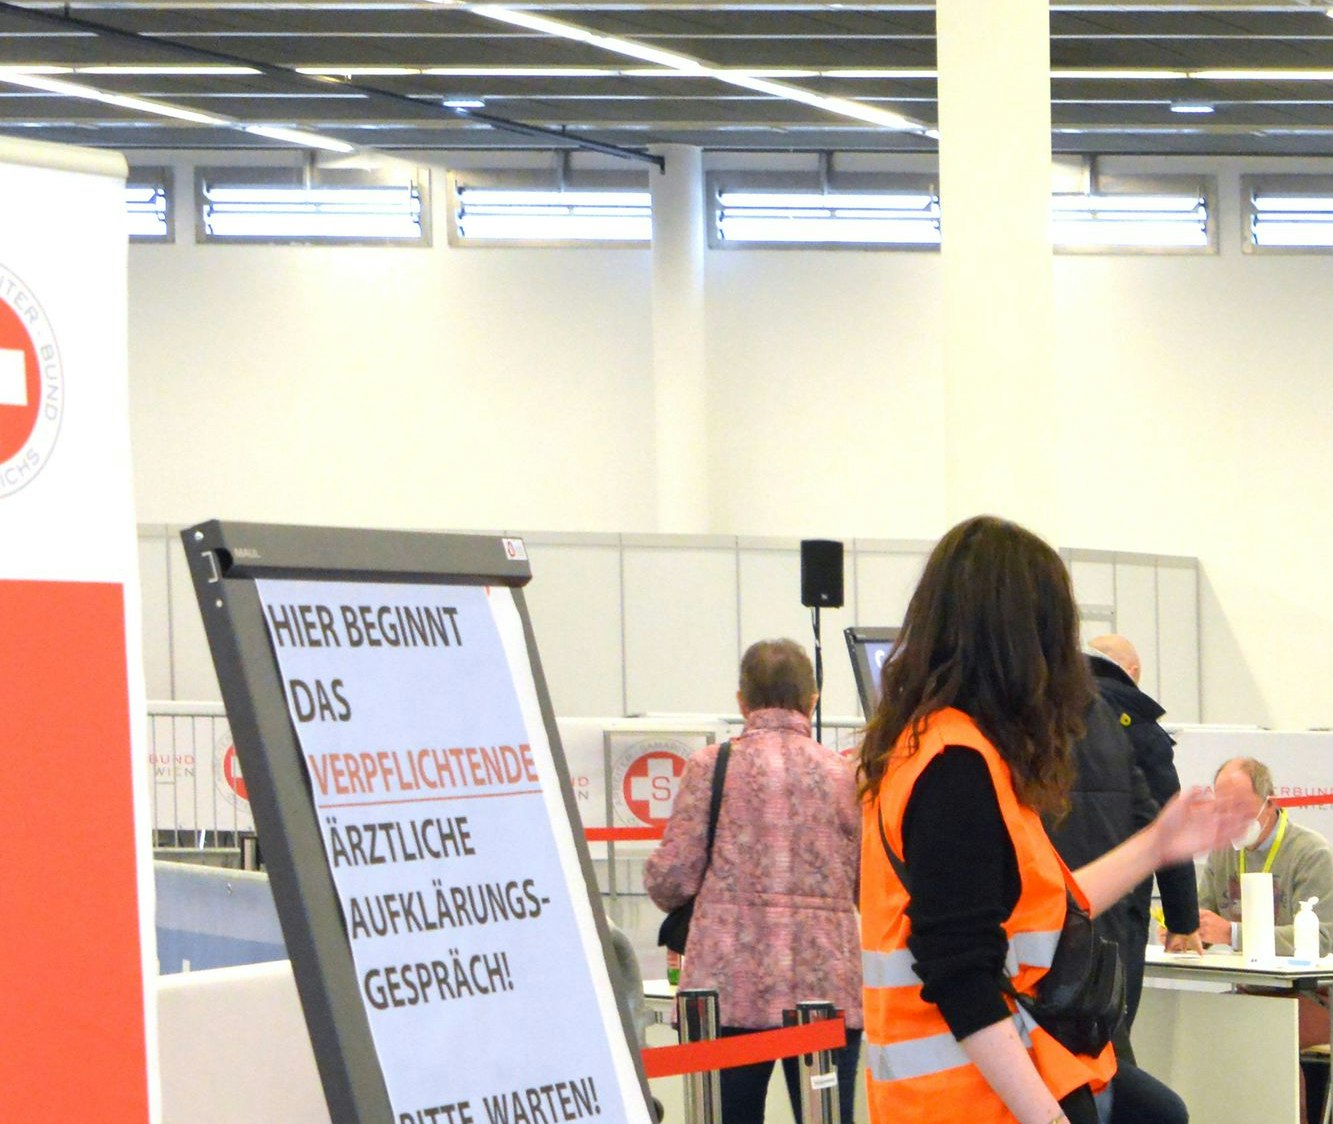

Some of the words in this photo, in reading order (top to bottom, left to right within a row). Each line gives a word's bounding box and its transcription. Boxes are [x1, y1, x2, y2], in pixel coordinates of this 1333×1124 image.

[40, 344, 59, 421] BUND
[267, 604, 339, 648] HIER
[340, 604, 463, 648] BEGINNT
[289, 678, 352, 723] DAS
[308, 743, 540, 796] VERPFLICHTENDE
[326, 816, 476, 868] ÄRZTLICHE
[350, 878, 551, 939] AUFKLÄRUNGS-
[364, 948, 514, 1010] GESPRÄCH!
